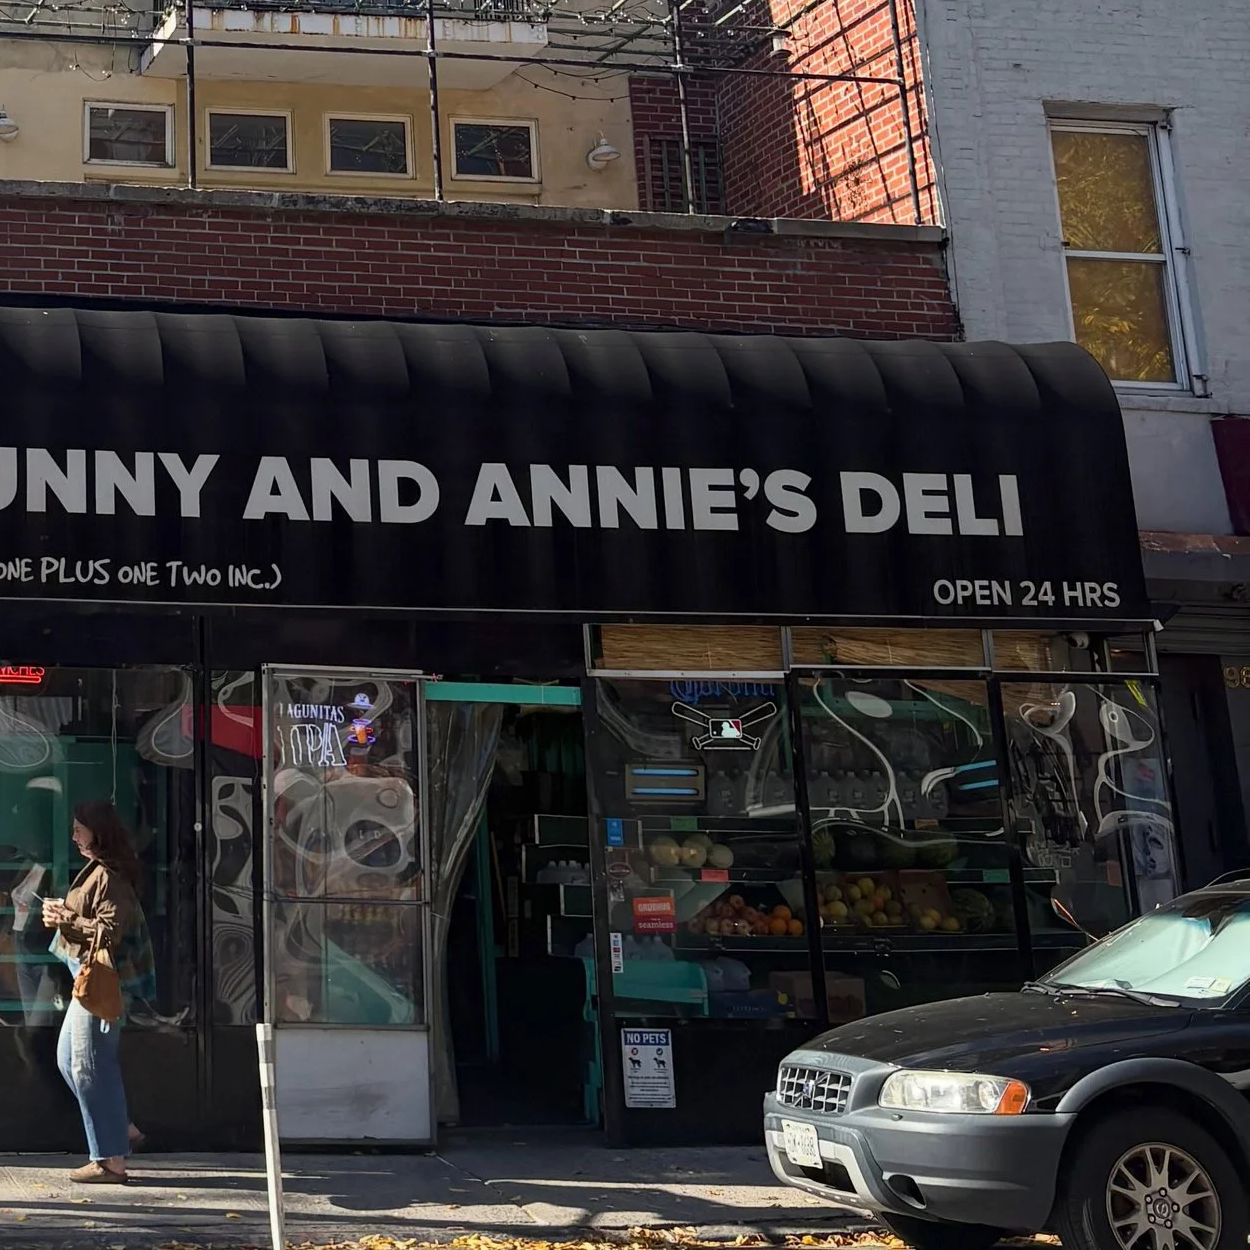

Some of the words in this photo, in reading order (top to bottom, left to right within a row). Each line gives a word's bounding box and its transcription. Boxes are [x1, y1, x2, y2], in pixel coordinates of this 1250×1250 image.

[243, 456, 440, 524] AND
[464, 462, 817, 533] ANNIE'S
[840, 471, 1024, 537] DELI
[41, 556, 110, 585] PLUS
[118, 561, 158, 587] ONE
[166, 561, 221, 588] TWO
[228, 563, 283, 591] INC.)
[933, 579, 1012, 606] OPEN
[1019, 580, 1056, 607] 24
[1063, 581, 1121, 609] HRS
[626, 1033, 640, 1044] NO
[643, 1033, 667, 1044] PETS
